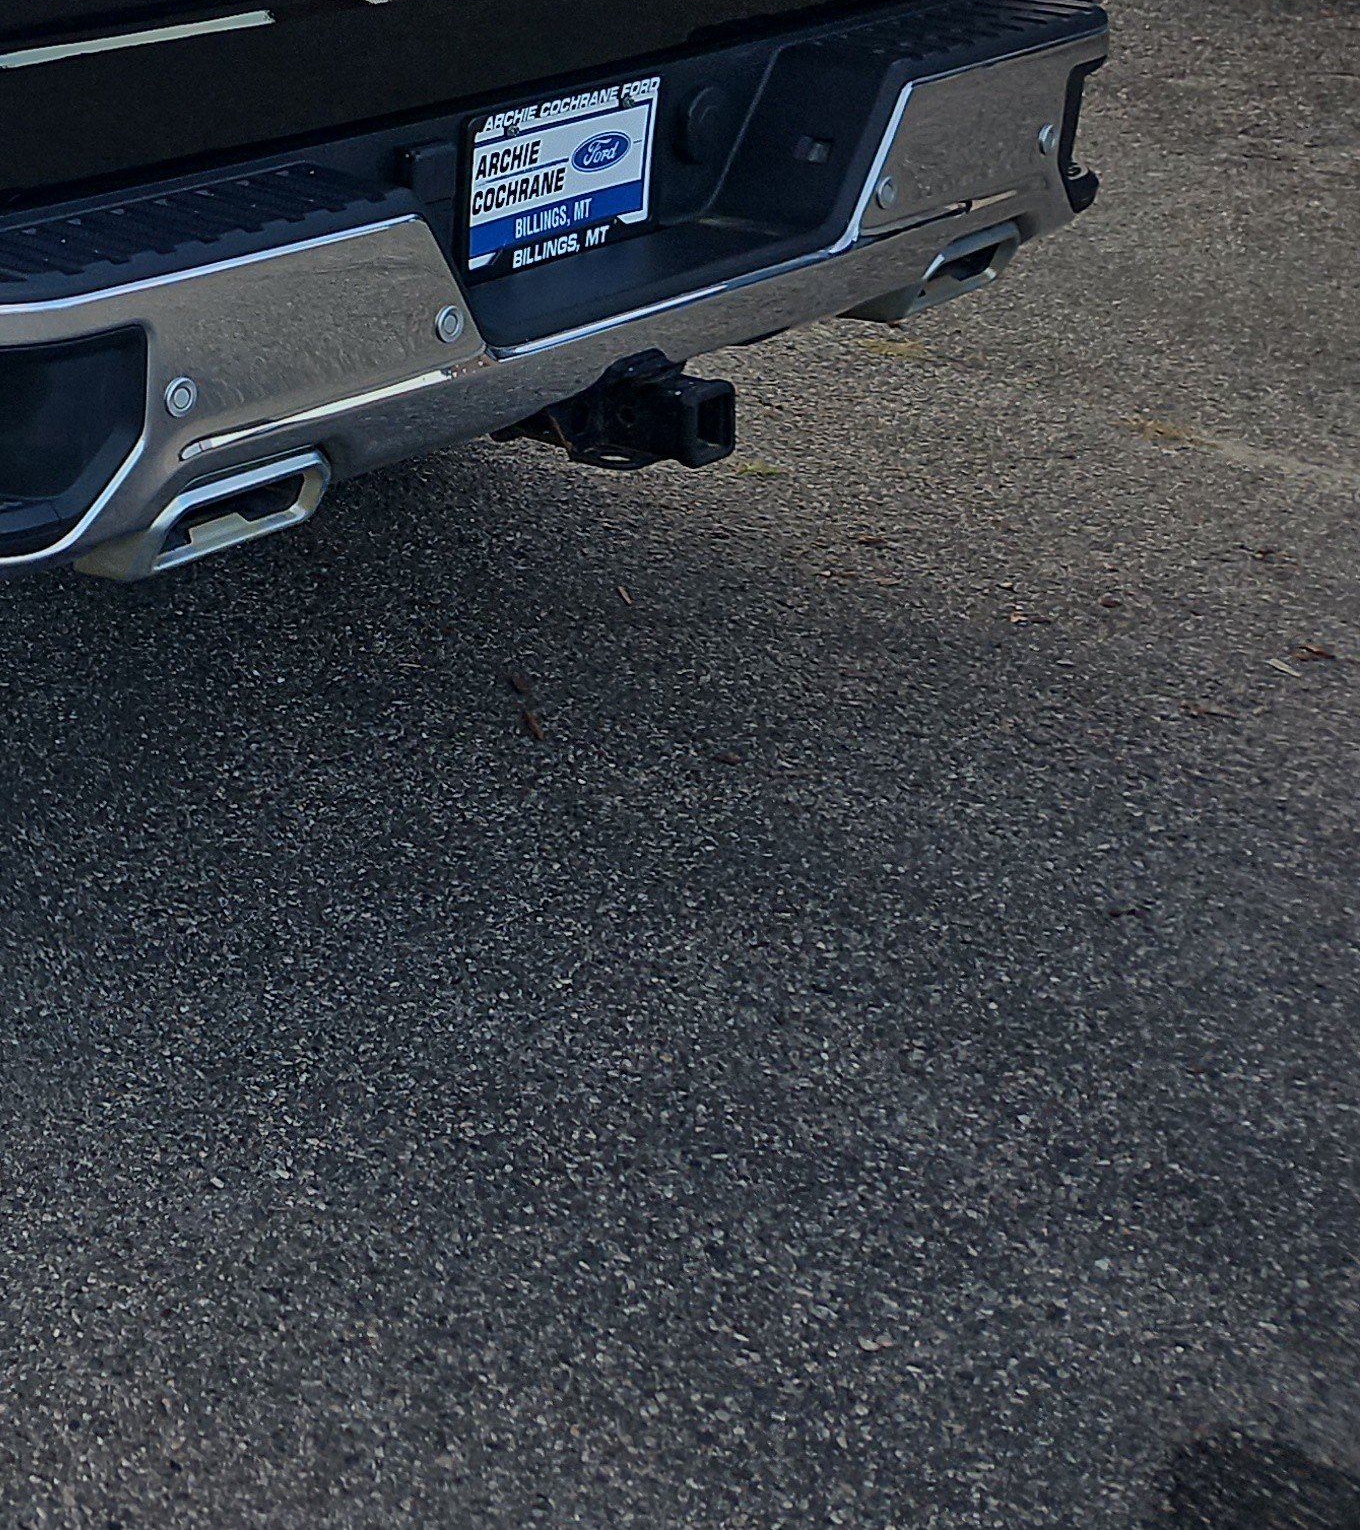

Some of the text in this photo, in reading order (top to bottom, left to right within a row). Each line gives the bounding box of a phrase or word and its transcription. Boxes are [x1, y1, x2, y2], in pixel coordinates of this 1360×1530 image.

[482, 76, 661, 134] ARCHIE COCHRANE FORD
[475, 139, 542, 181] ARCHIE
[583, 138, 620, 166] Ford
[472, 167, 567, 216] COCHRANE
[514, 198, 593, 239] BILLINGS, MT
[512, 224, 611, 269] BILLINGS, MT
